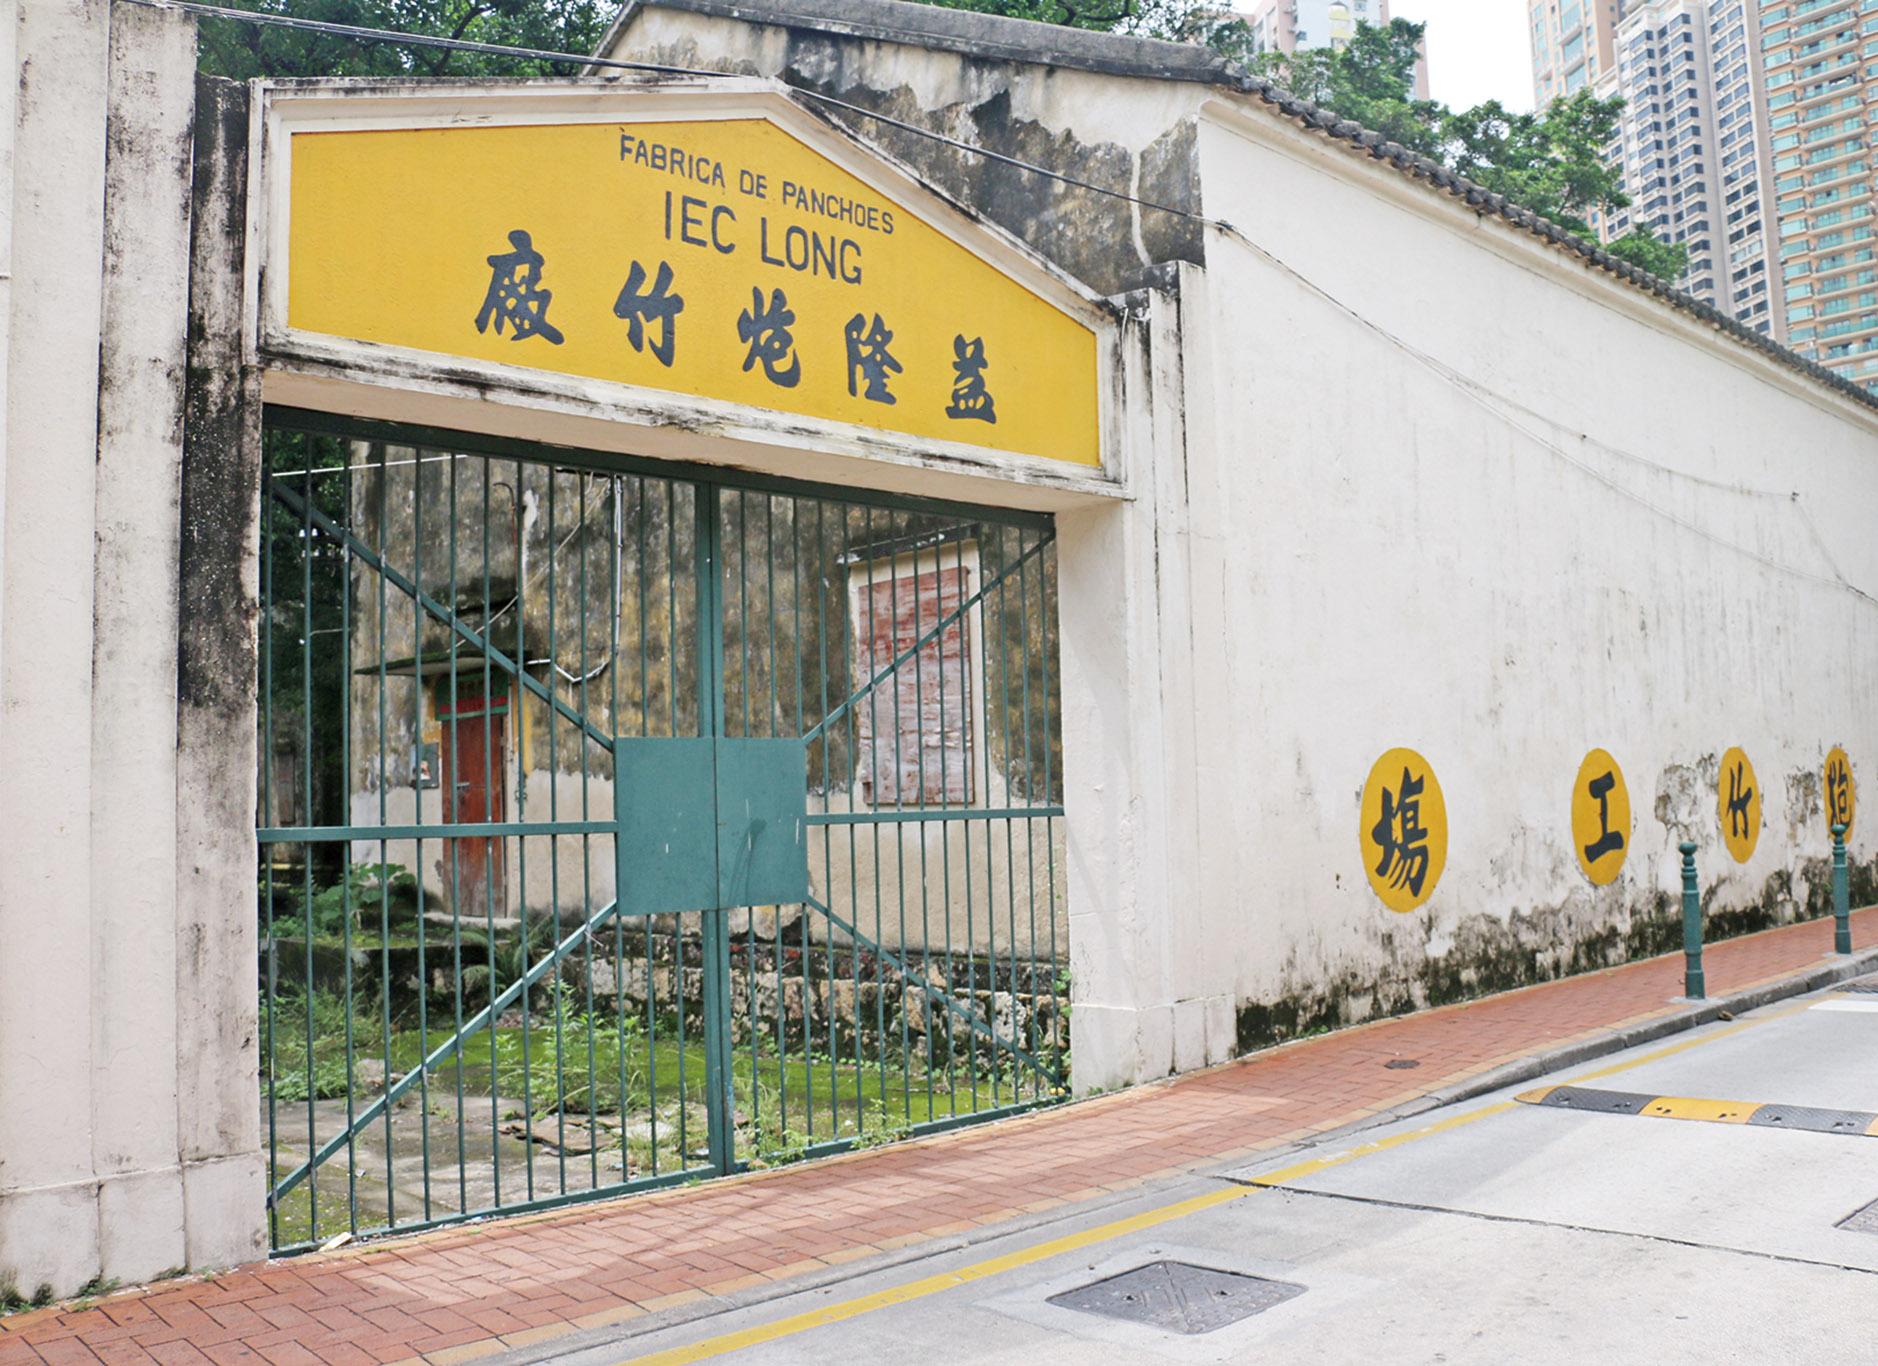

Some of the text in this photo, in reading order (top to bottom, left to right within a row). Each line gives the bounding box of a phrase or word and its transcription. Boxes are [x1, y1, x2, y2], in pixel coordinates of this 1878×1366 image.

[620, 134, 895, 236] FABRICA DE PANCHOES
[665, 190, 862, 286] IEC LONG
[1371, 766, 1430, 898] 場
[1583, 770, 1626, 864] 工
[1726, 760, 1753, 841] 竹
